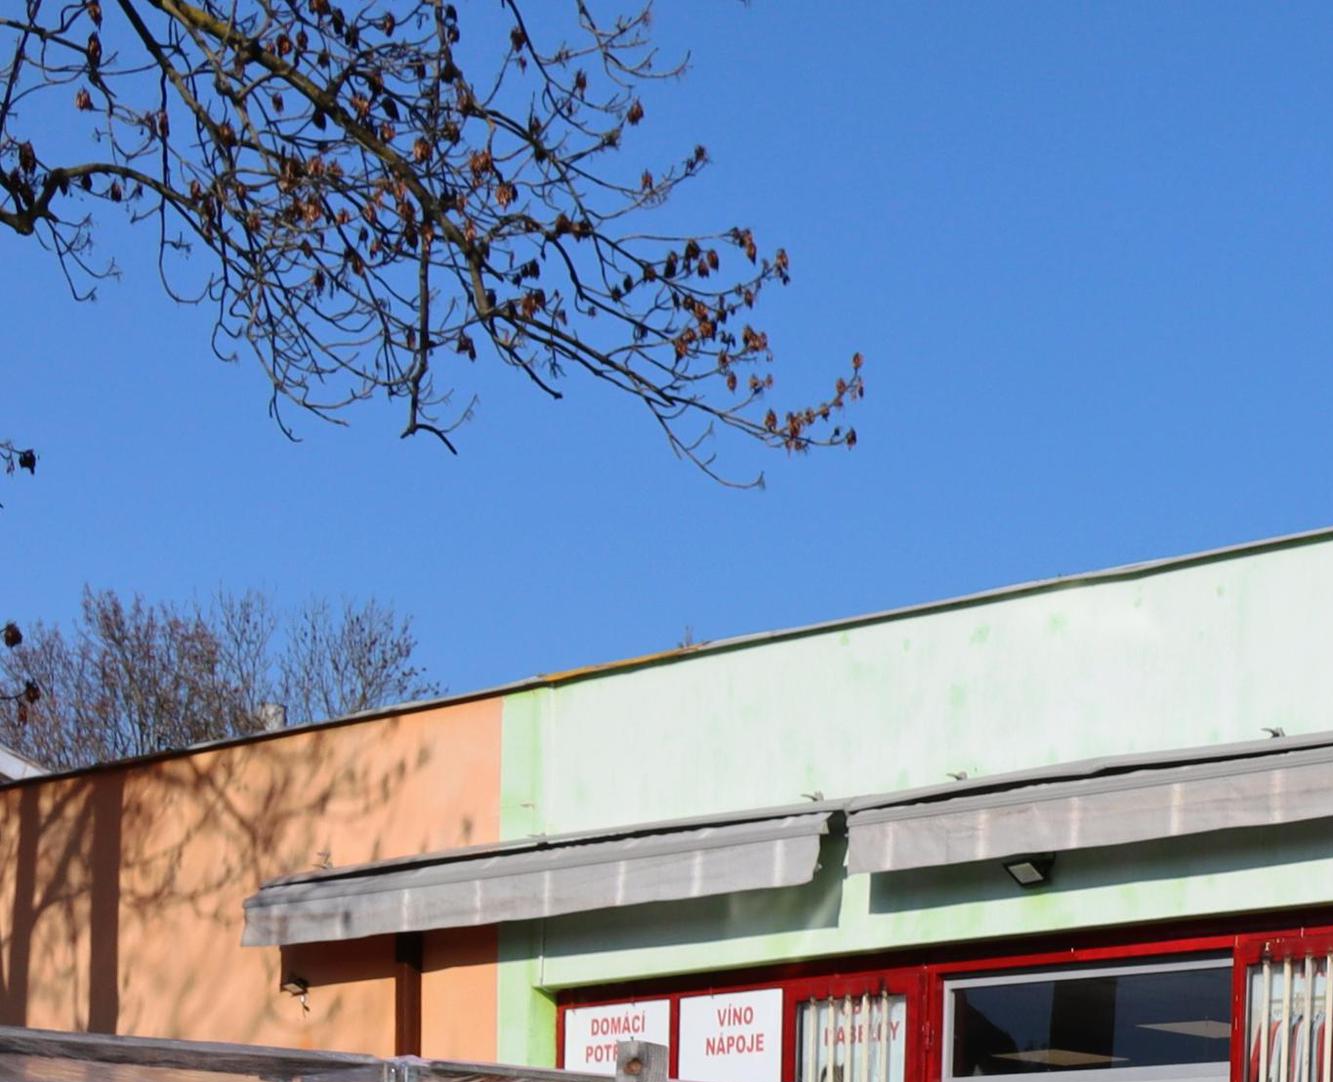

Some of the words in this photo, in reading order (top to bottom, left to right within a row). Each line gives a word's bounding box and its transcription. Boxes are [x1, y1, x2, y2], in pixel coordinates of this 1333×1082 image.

[590, 1010, 646, 1037] DOMÁCÍ
[717, 1002, 754, 1028] VÍNO
[705, 1031, 765, 1056] NÁPOJE
